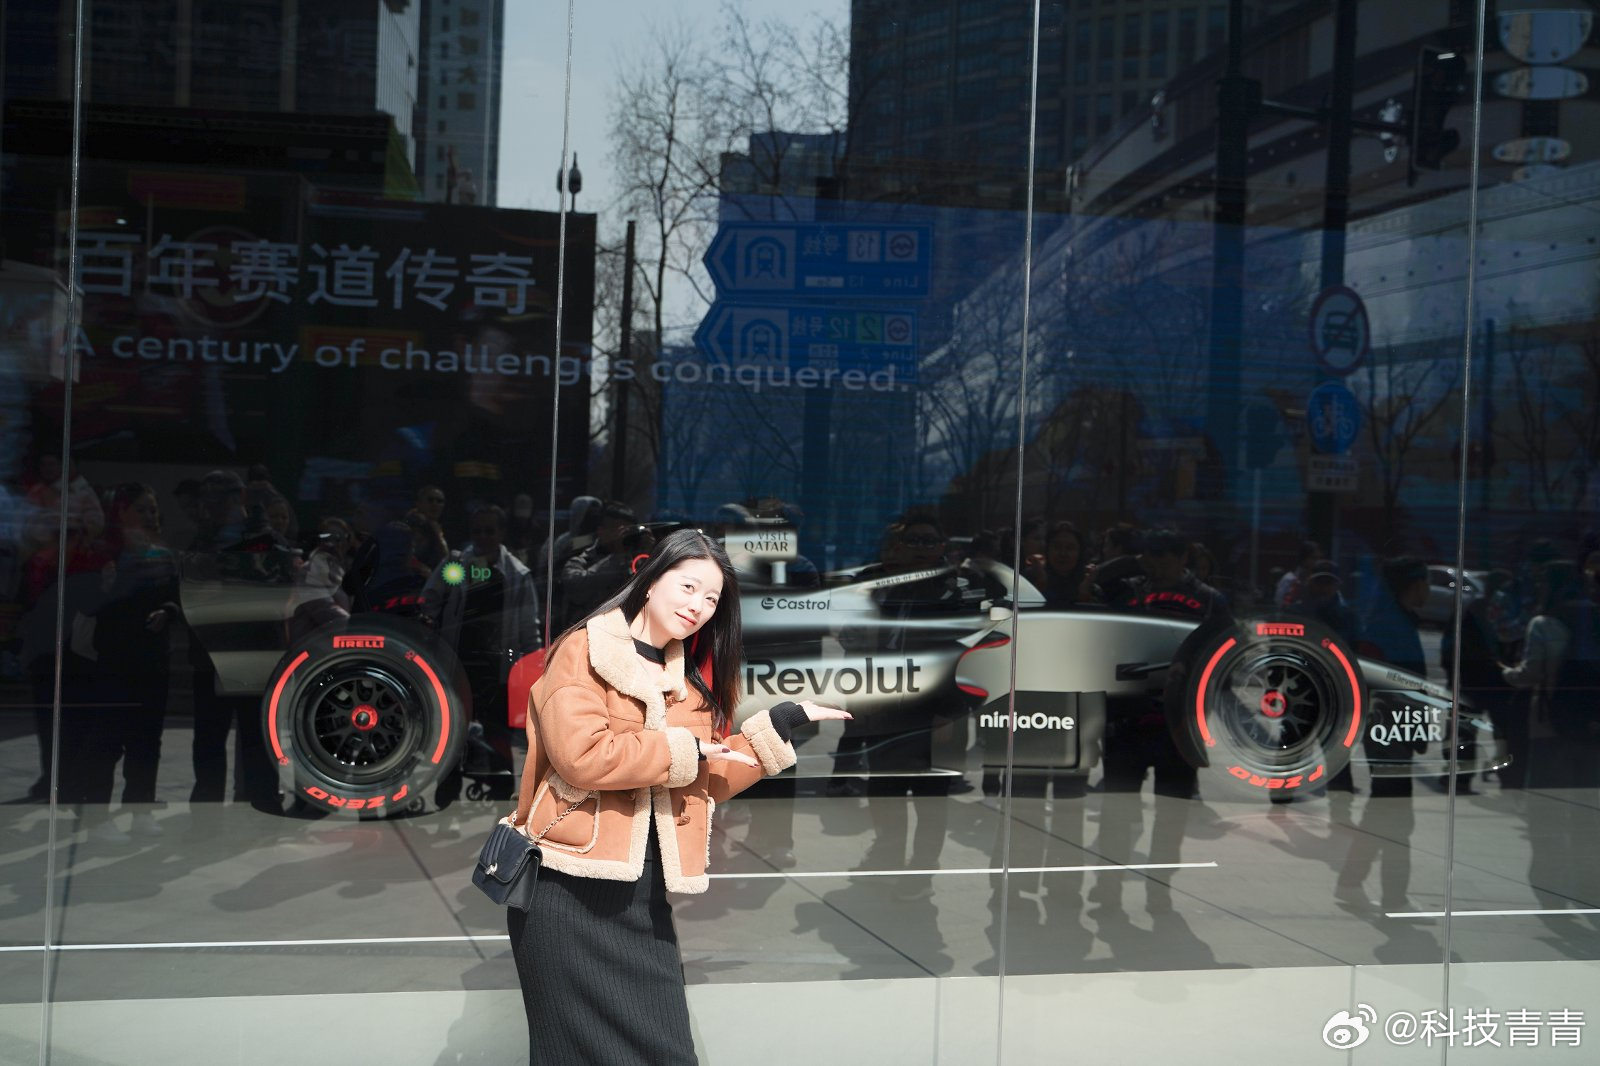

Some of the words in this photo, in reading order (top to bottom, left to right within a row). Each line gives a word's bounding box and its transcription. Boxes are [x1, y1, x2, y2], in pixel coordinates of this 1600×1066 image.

[70, 231, 536, 315] 百年赛道传奇
[59, 323, 97, 357] A
[111, 333, 299, 374] century
[314, 338, 367, 370] of
[651, 360, 909, 393] conquered.
[757, 529, 789, 541] visit
[744, 540, 789, 553] QATAR
[471, 565, 492, 581] bp
[776, 598, 831, 611] Castrol
[1256, 622, 1305, 636] PIRELLI
[333, 635, 386, 649] PIRELLI
[746, 658, 921, 696] Revolut
[979, 711, 1075, 733] ninjaOne
[1391, 705, 1442, 724] visit
[1370, 724, 1442, 746] QATAR
[1228, 766, 1304, 789] ZERO
[1308, 764, 1324, 783] P
[306, 786, 386, 810] ZERO
[392, 784, 408, 802] P
